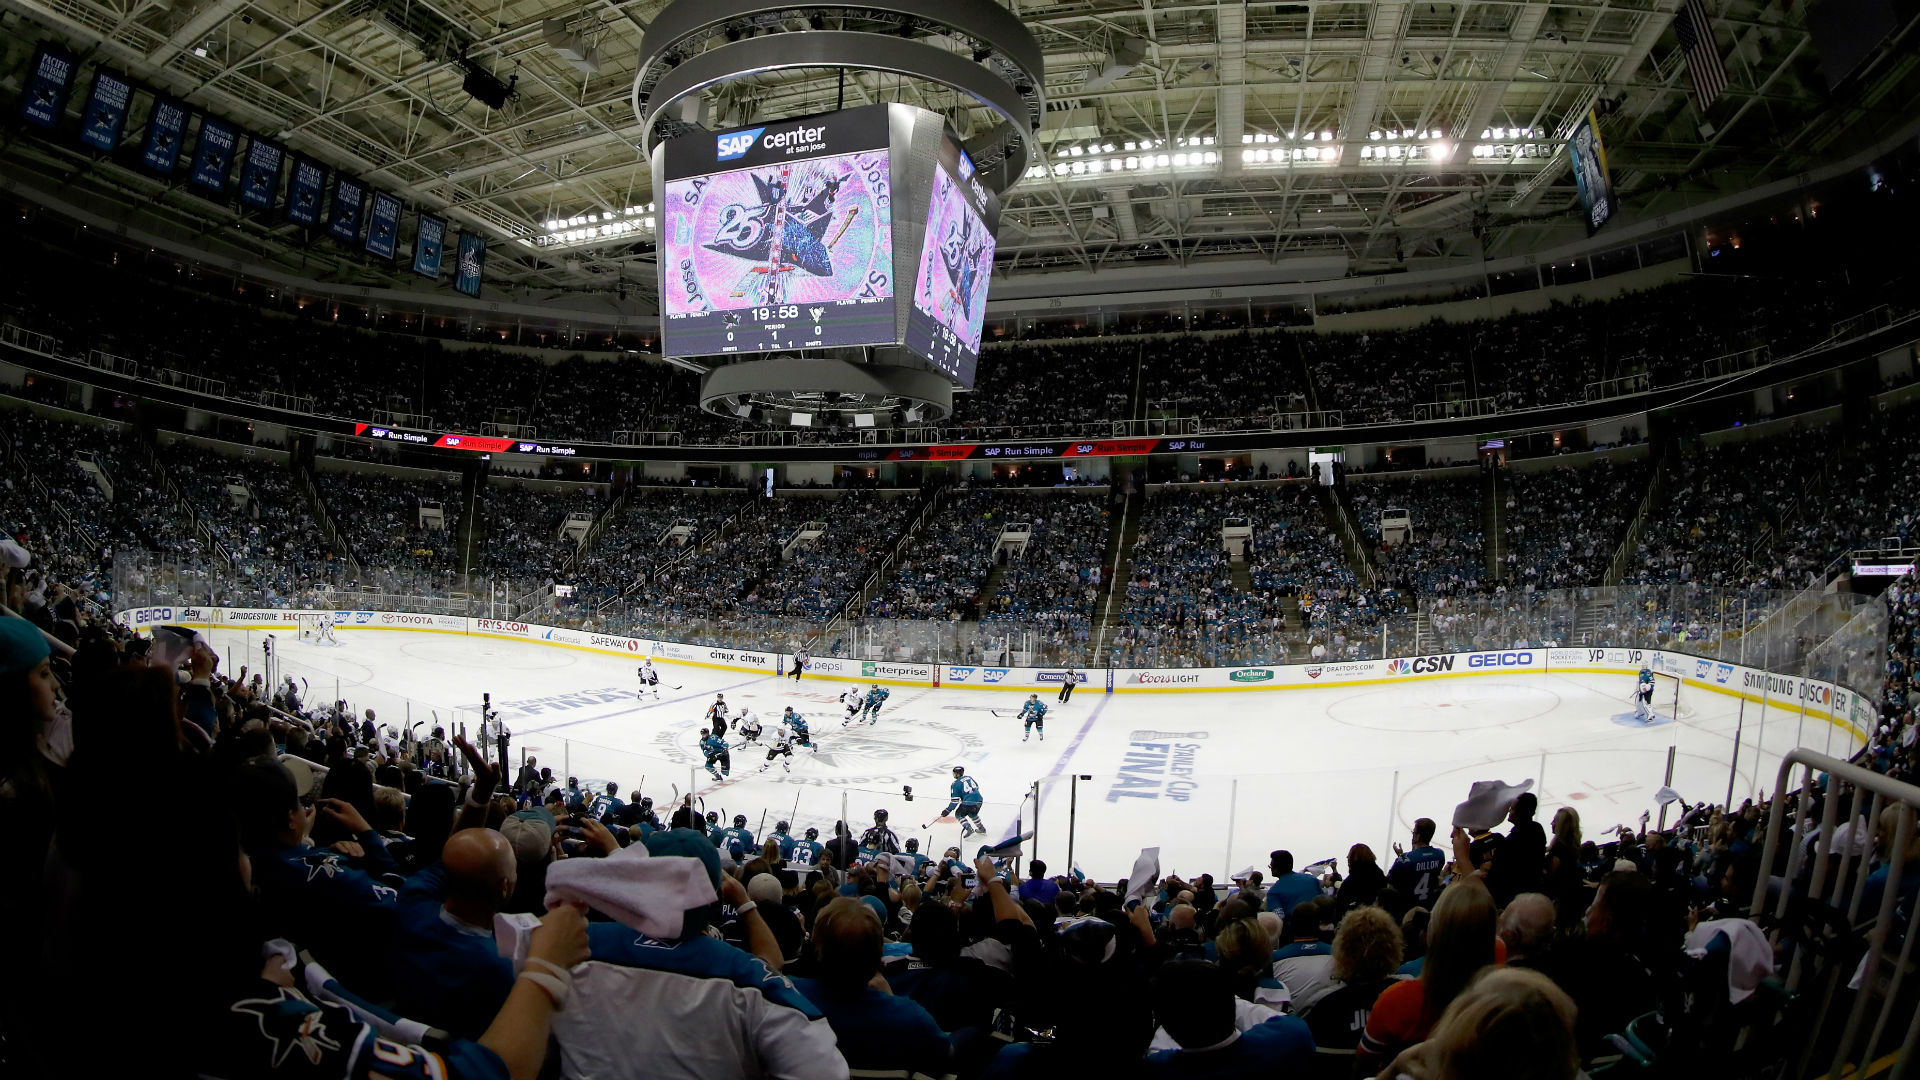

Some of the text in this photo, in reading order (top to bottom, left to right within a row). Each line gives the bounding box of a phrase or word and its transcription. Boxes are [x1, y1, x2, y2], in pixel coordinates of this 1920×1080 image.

[42, 52, 70, 73] PACIFIC
[40, 62, 67, 80] DIVISION
[100, 73, 130, 94] WESTERN
[205, 130, 233, 150] TROPHY
[718, 125, 826, 157] SAP center
[786, 142, 826, 155] at san jose
[959, 154, 972, 181] SAP
[340, 180, 362, 194] PACIFIC
[378, 196, 398, 208] PACIFIC
[423, 220, 442, 232] PACIFIC
[752, 306, 798, 324] 19:58
[728, 332, 734, 342] 0
[772, 330, 778, 341] 1
[815, 326, 822, 336] 0
[372, 429, 428, 444] SAP Run Simple
[447, 438, 502, 450] SAP Run Simple
[520, 444, 534, 452] SAP
[552, 446, 576, 456] Simple
[985, 446, 1054, 456] SAP Run Simple
[1077, 445, 1093, 454] SAP
[1097, 444, 1116, 452] Run
[1169, 442, 1186, 450] SAP
[900, 450, 914, 458] SAP
[136, 608, 172, 624] GEICO
[184, 607, 200, 619] day
[230, 612, 278, 621] BRIDGESTONE
[335, 613, 348, 622] SAP
[356, 613, 370, 622] SAP
[396, 616, 433, 625] TOYOTA
[477, 619, 529, 633] FRYS.COM
[554, 634, 582, 646] Barracuda
[590, 636, 628, 650] SAFEWAY
[1468, 652, 1533, 668] GEICO
[1588, 649, 1642, 664] yp yp
[814, 660, 843, 674] pepsi
[864, 664, 928, 678] enterprise
[1326, 664, 1375, 673] DRAFTOPS.COM
[1412, 655, 1456, 674] CSN
[1696, 662, 1709, 675] SAP
[1717, 666, 1730, 680] SAP
[950, 669, 970, 680] SAP
[984, 670, 1006, 681] SAP
[1139, 672, 1200, 684] Coors LIGHT
[1236, 670, 1267, 678] Orchard
[1744, 672, 1793, 696] SAMSUNG
[518, 690, 638, 715] FINAL
[1798, 682, 1846, 713] DISCOVER
[1105, 742, 1171, 803] FINAL
[1164, 743, 1202, 802] STANLEY CUP
[962, 778, 980, 794] 44
[597, 804, 606, 820] 9
[792, 847, 812, 866] 83
[1416, 860, 1439, 872] DILLON
[1414, 873, 1431, 901] 4
